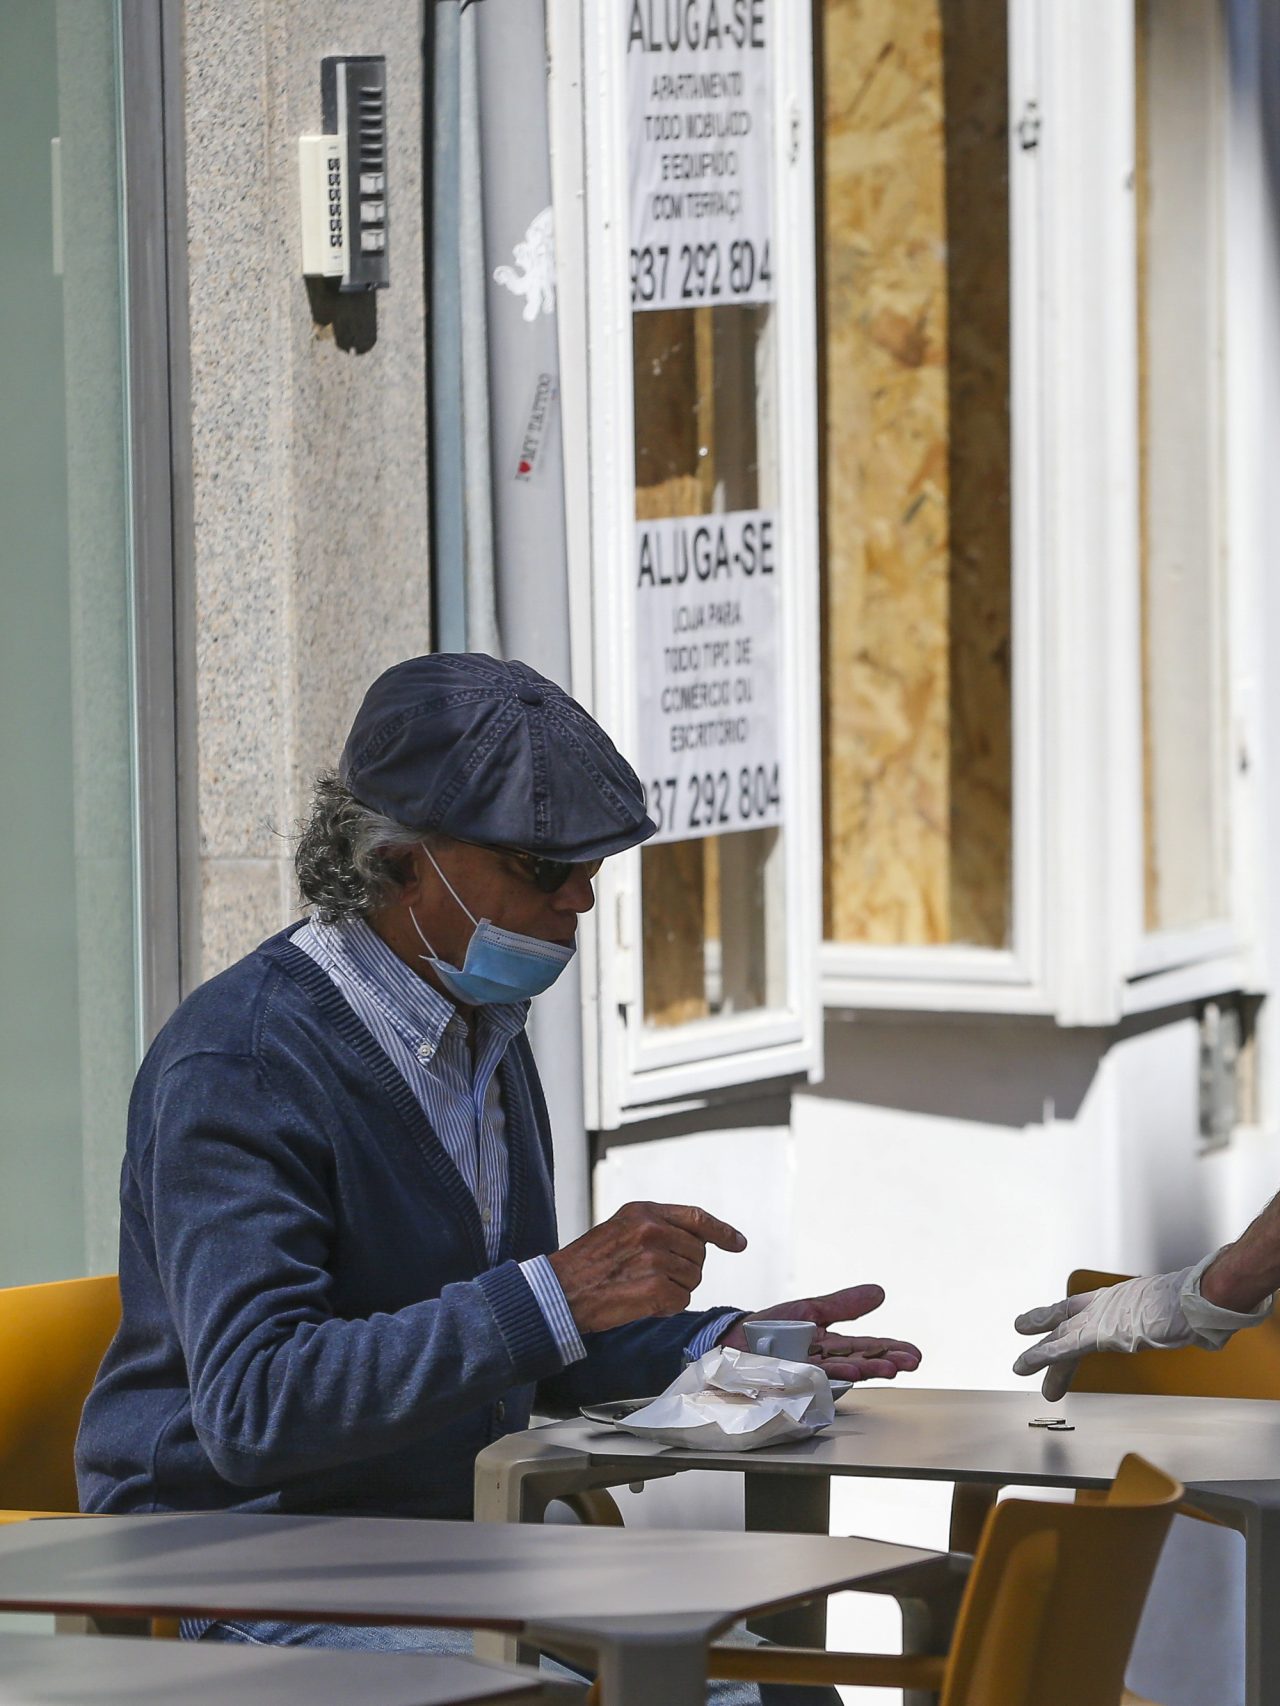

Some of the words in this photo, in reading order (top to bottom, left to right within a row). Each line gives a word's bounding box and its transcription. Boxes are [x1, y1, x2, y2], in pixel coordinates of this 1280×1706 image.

[627, 0, 764, 52] ALUGA-SE
[651, 71, 743, 100] APARTAMENTO
[644, 113, 681, 141] TODO
[652, 193, 682, 220] COM
[681, 242, 721, 298] 292
[730, 239, 771, 294] 804
[527, 373, 552, 432] TATTOO
[520, 434, 540, 461] MY
[637, 522, 774, 588] ALUGA-SE
[672, 604, 705, 635] LOJA
[708, 600, 742, 628] PARA
[664, 644, 699, 674] TODO
[703, 640, 731, 671] TIPO
[735, 636, 752, 666] DE
[735, 677, 753, 706] OU
[688, 770, 730, 829] 292
[739, 762, 781, 820] 804
